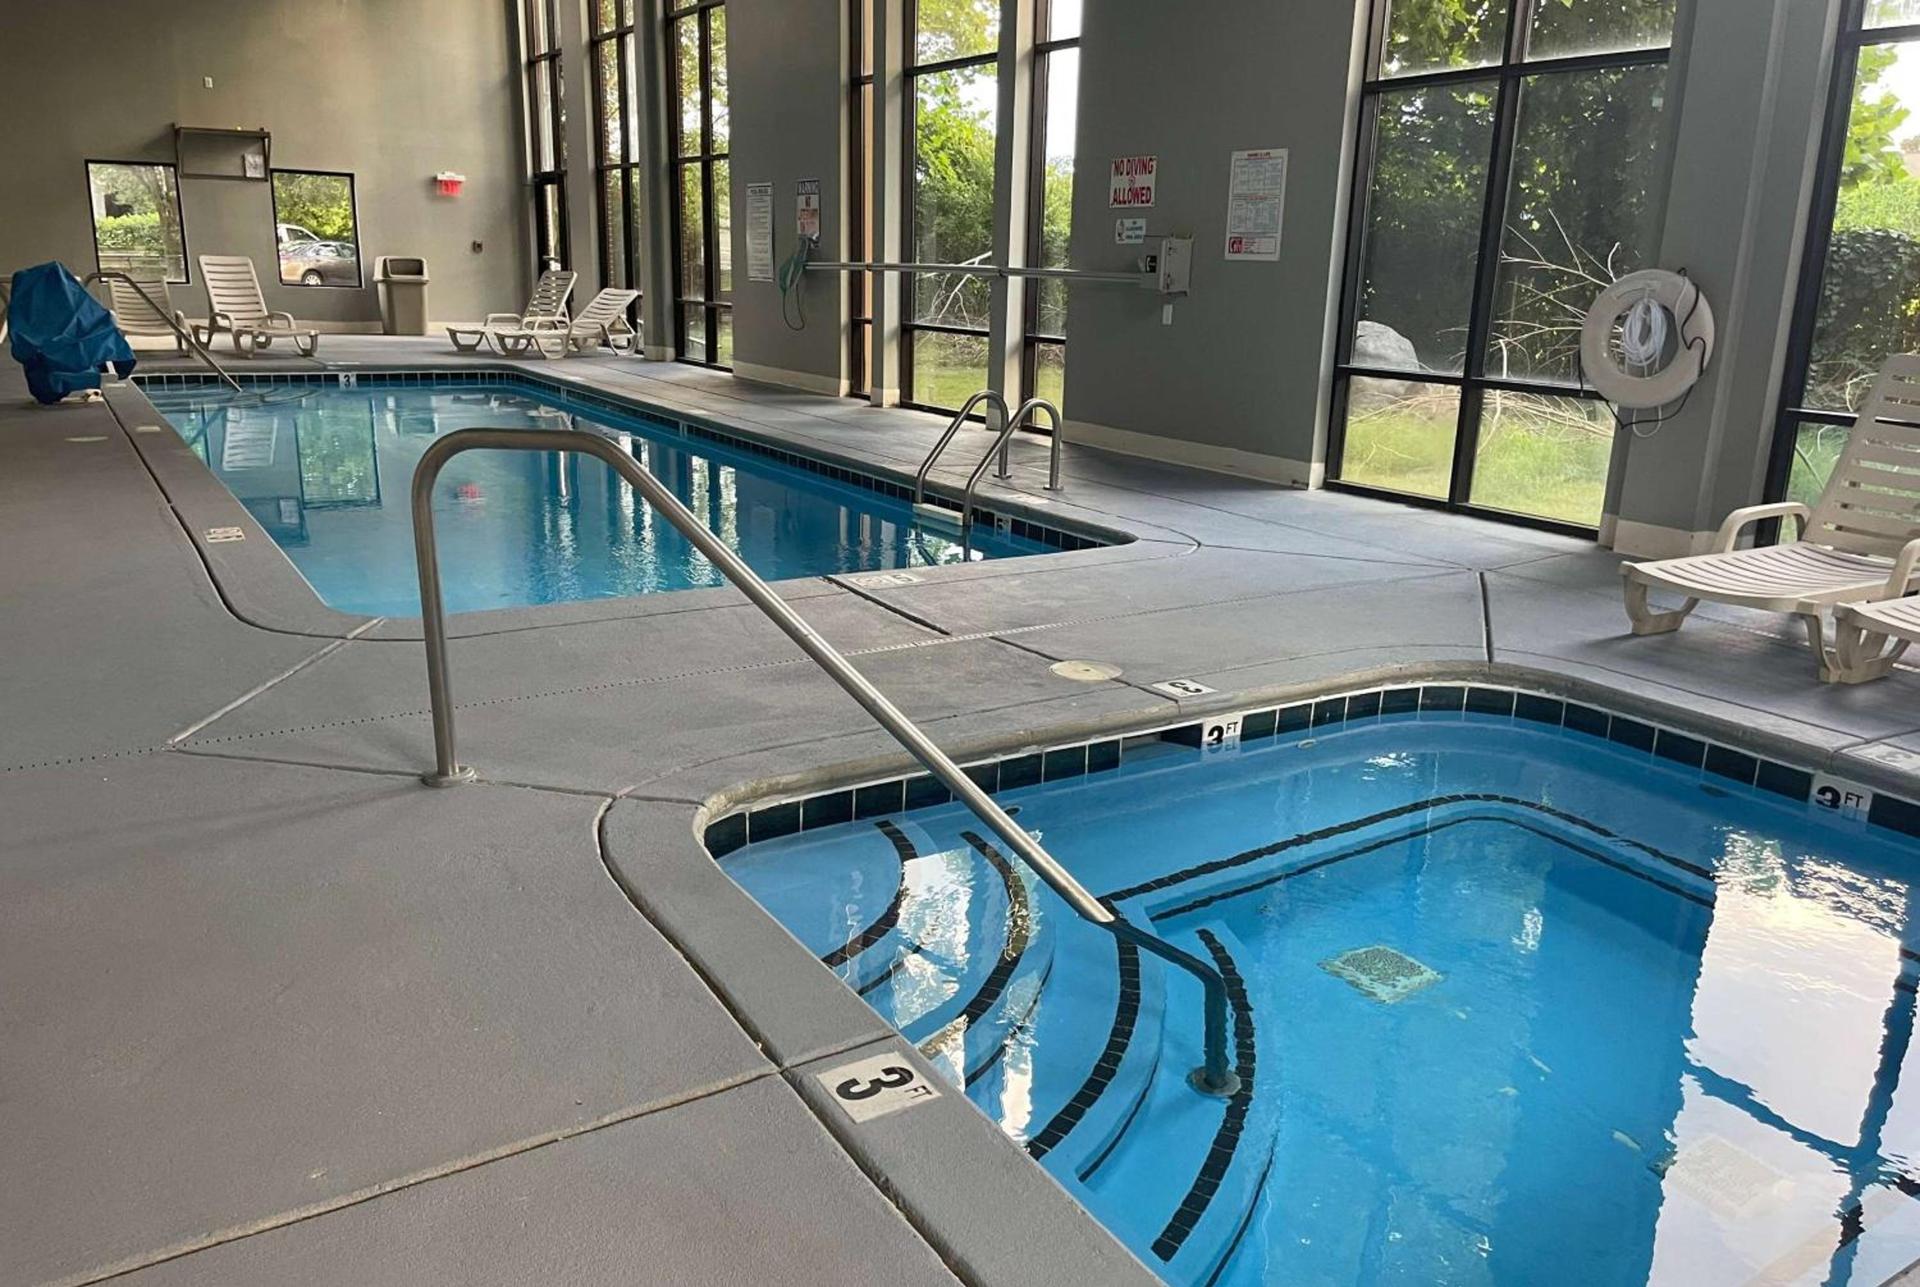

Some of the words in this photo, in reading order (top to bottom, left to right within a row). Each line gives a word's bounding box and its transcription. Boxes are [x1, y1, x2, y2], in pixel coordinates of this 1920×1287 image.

[1113, 159, 1125, 177] NO
[1126, 157, 1154, 176] DIVING
[1112, 186, 1152, 205] ALLOWED
[344, 374, 351, 387] 3
[1207, 725, 1224, 746] 3
[1225, 721, 1239, 735] FT
[1816, 786, 1841, 810] 3
[1844, 791, 1864, 808] FT
[836, 1066, 914, 1100] 3
[904, 1085, 932, 1099] FT
